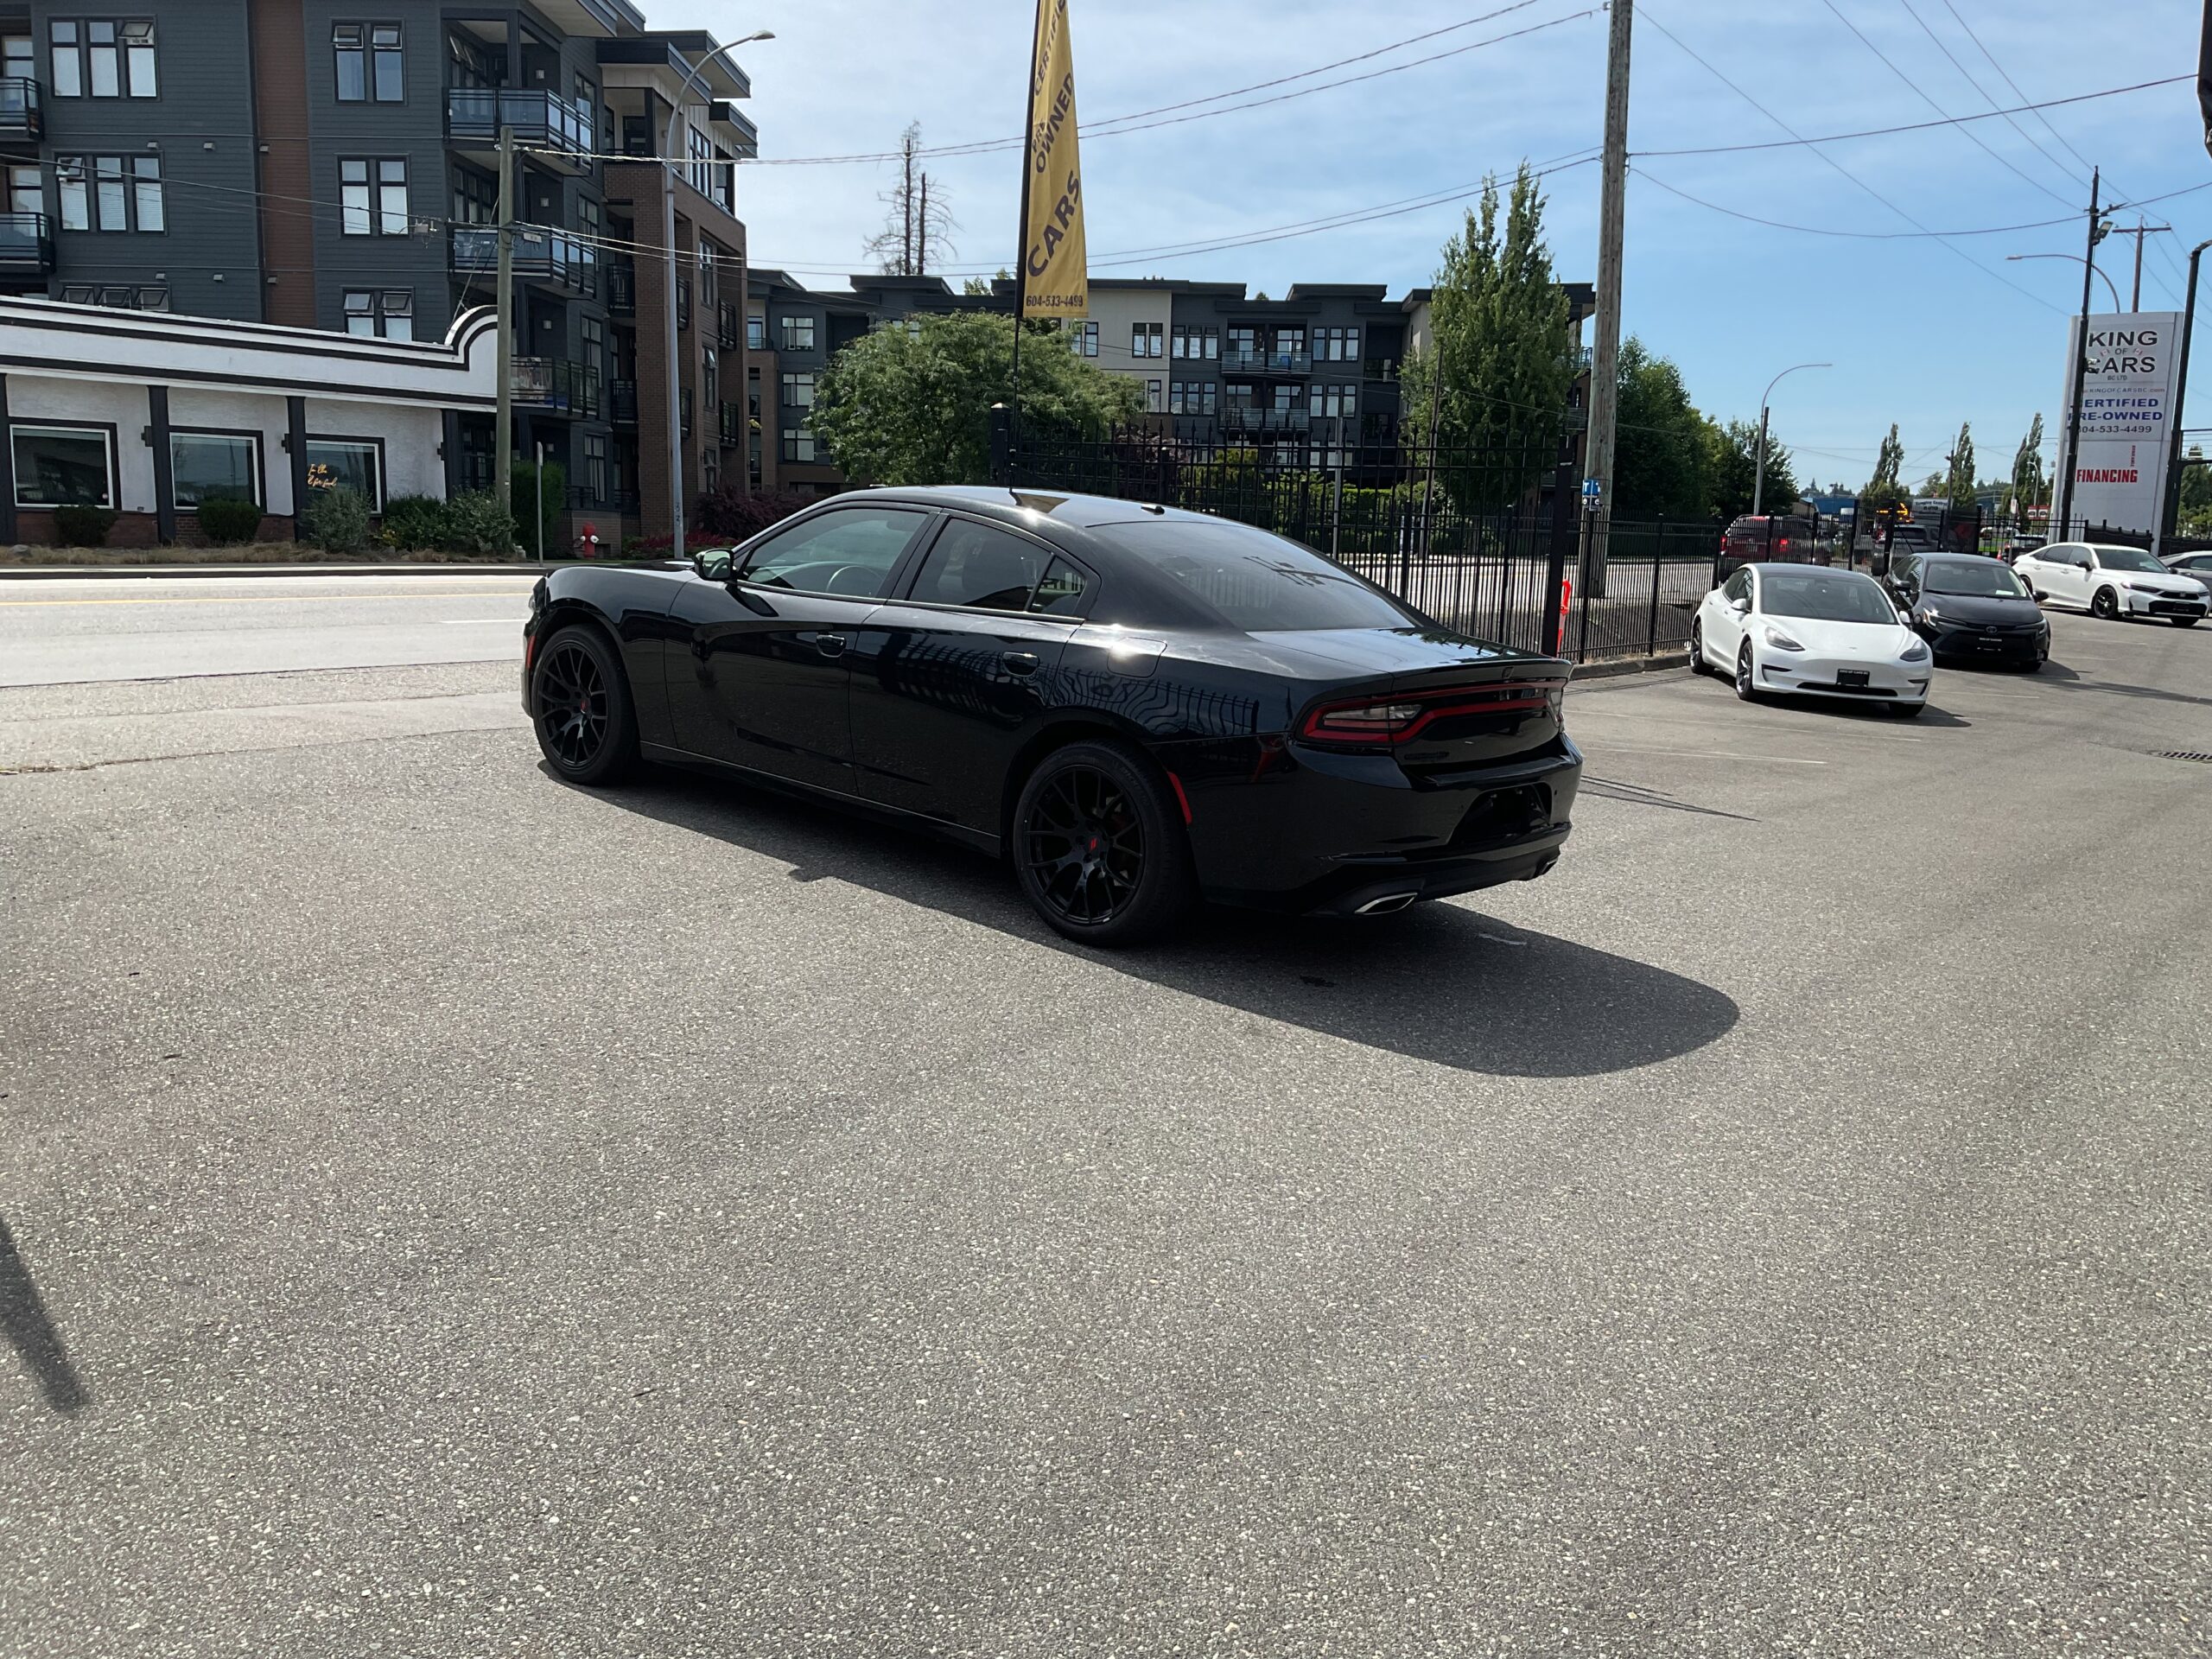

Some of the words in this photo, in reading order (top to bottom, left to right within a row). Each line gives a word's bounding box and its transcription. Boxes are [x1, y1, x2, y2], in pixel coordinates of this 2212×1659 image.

[1036, 73, 1073, 173] OWNED
[1027, 169, 1079, 277] CARS
[2088, 331, 2158, 347] KING
[2082, 398, 2158, 408] ERTIFIED
[2075, 469, 2138, 483] FINANCING
